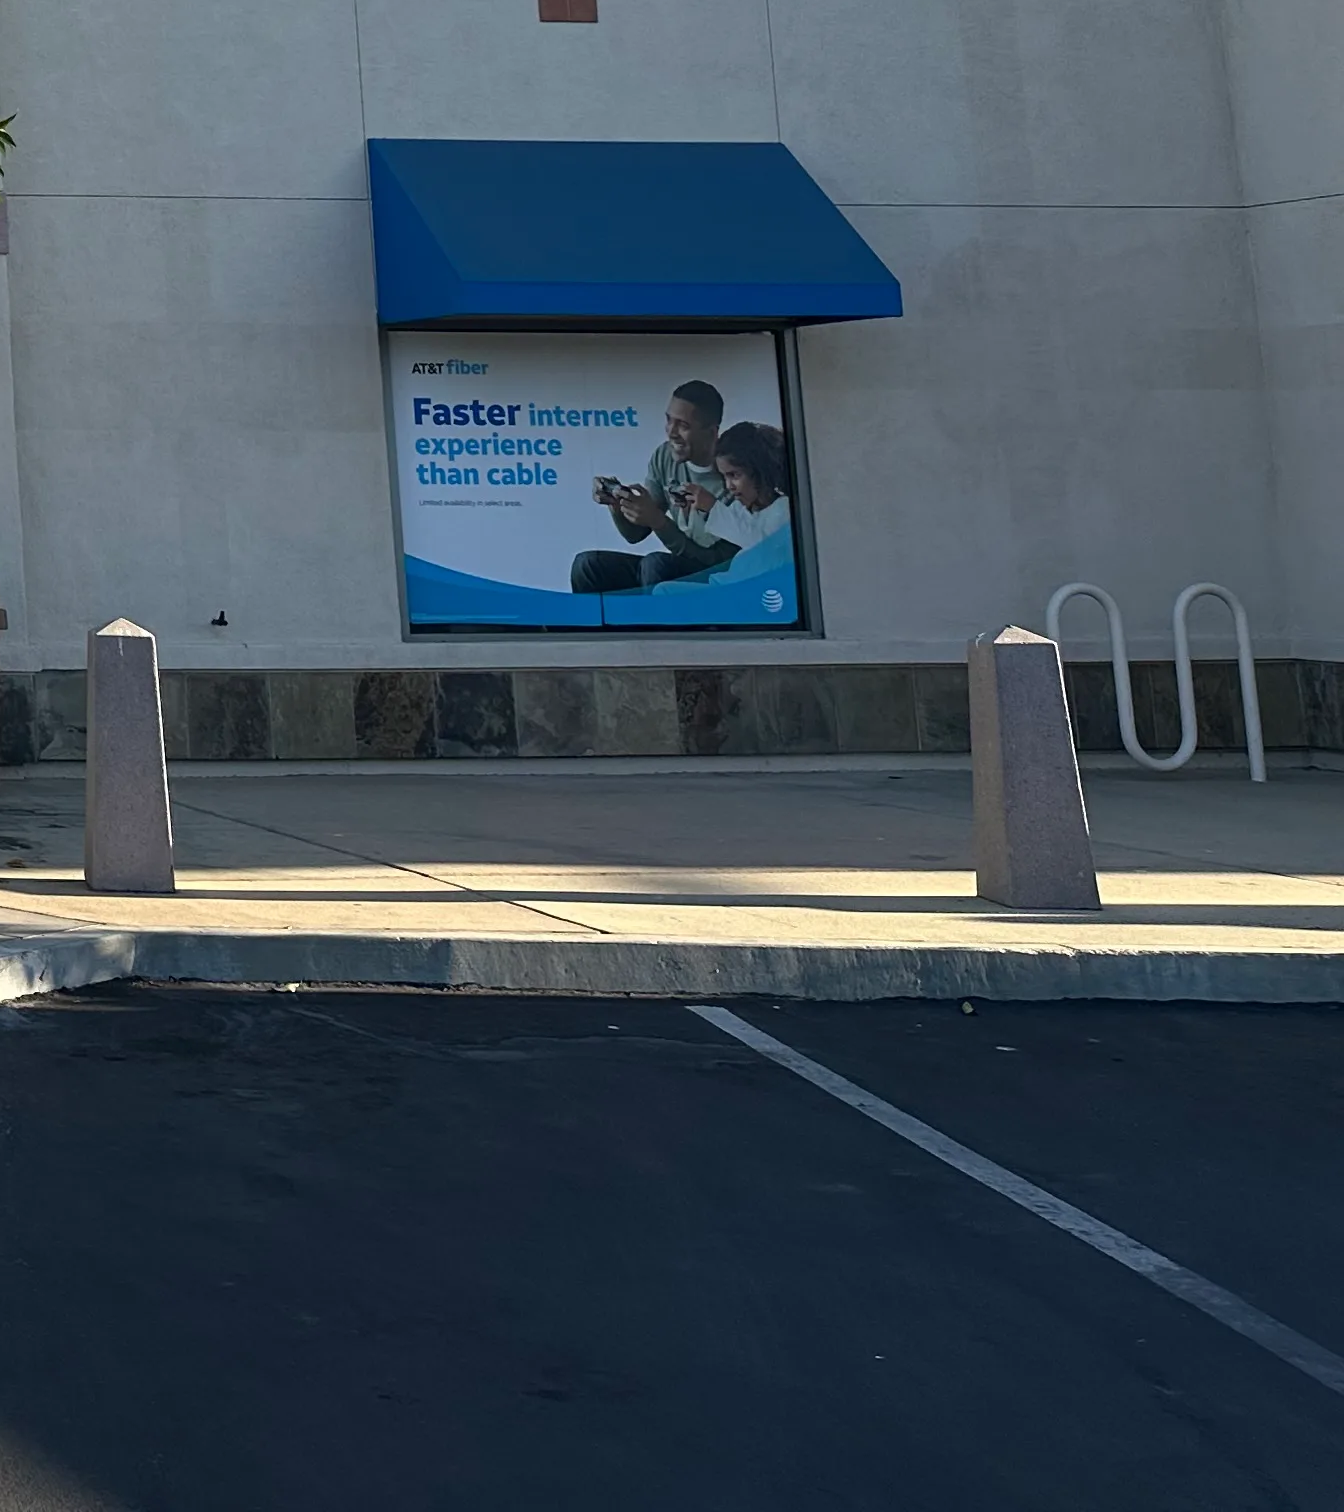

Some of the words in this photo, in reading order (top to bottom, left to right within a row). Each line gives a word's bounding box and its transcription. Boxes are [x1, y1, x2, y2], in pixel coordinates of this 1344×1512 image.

[412, 362, 444, 375] AT&T
[447, 359, 489, 375] fiber
[413, 397, 521, 426] Faster
[528, 403, 639, 427] internet
[415, 432, 562, 462] experience
[416, 461, 480, 485] than
[487, 462, 558, 485] cable
